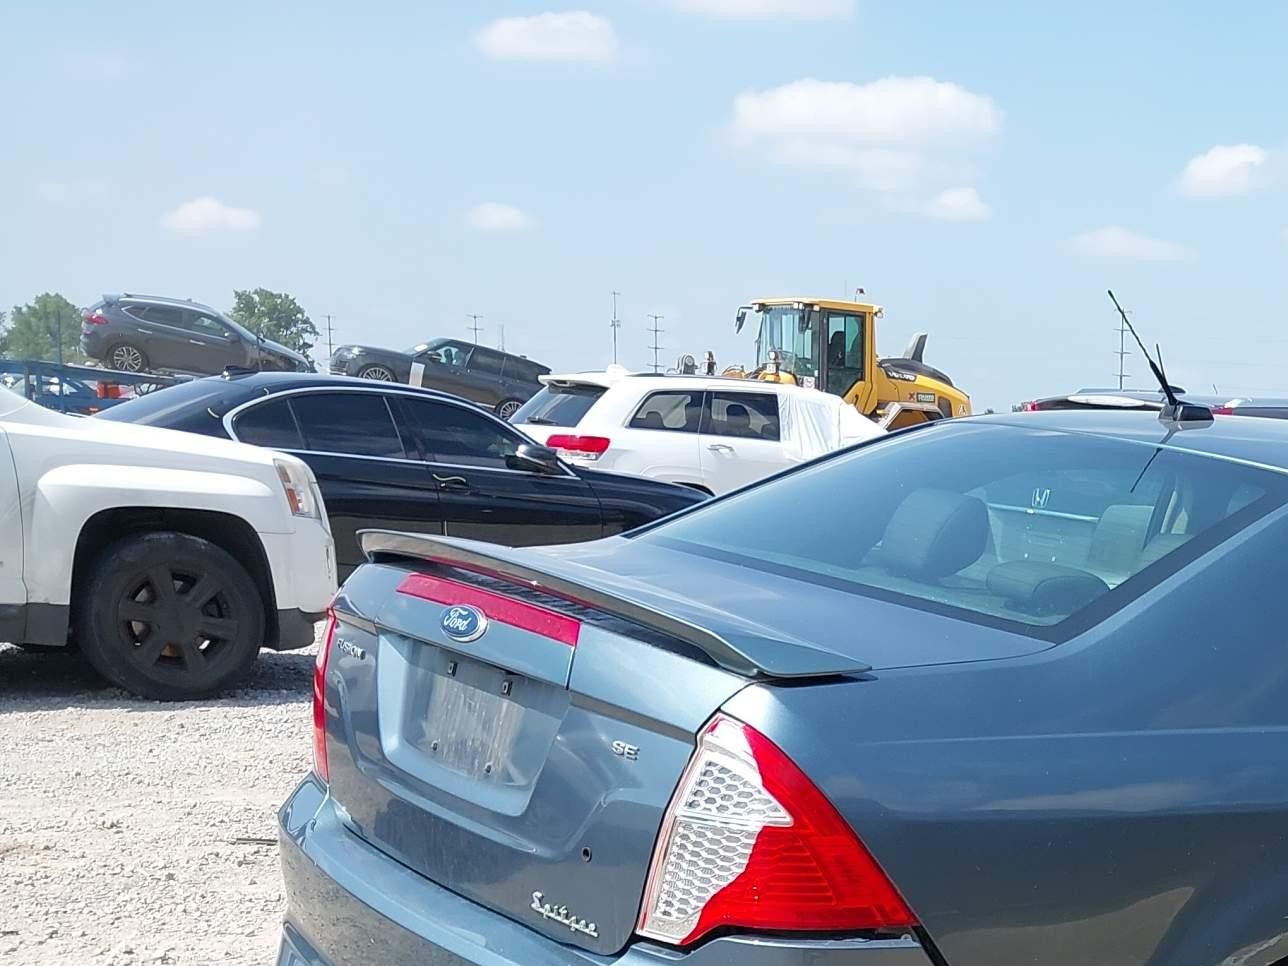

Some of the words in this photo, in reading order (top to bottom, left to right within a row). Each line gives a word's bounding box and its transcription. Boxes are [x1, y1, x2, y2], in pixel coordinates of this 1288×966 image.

[443, 607, 473, 631] Ford
[336, 638, 365, 660] FUSION
[612, 740, 640, 760] SE
